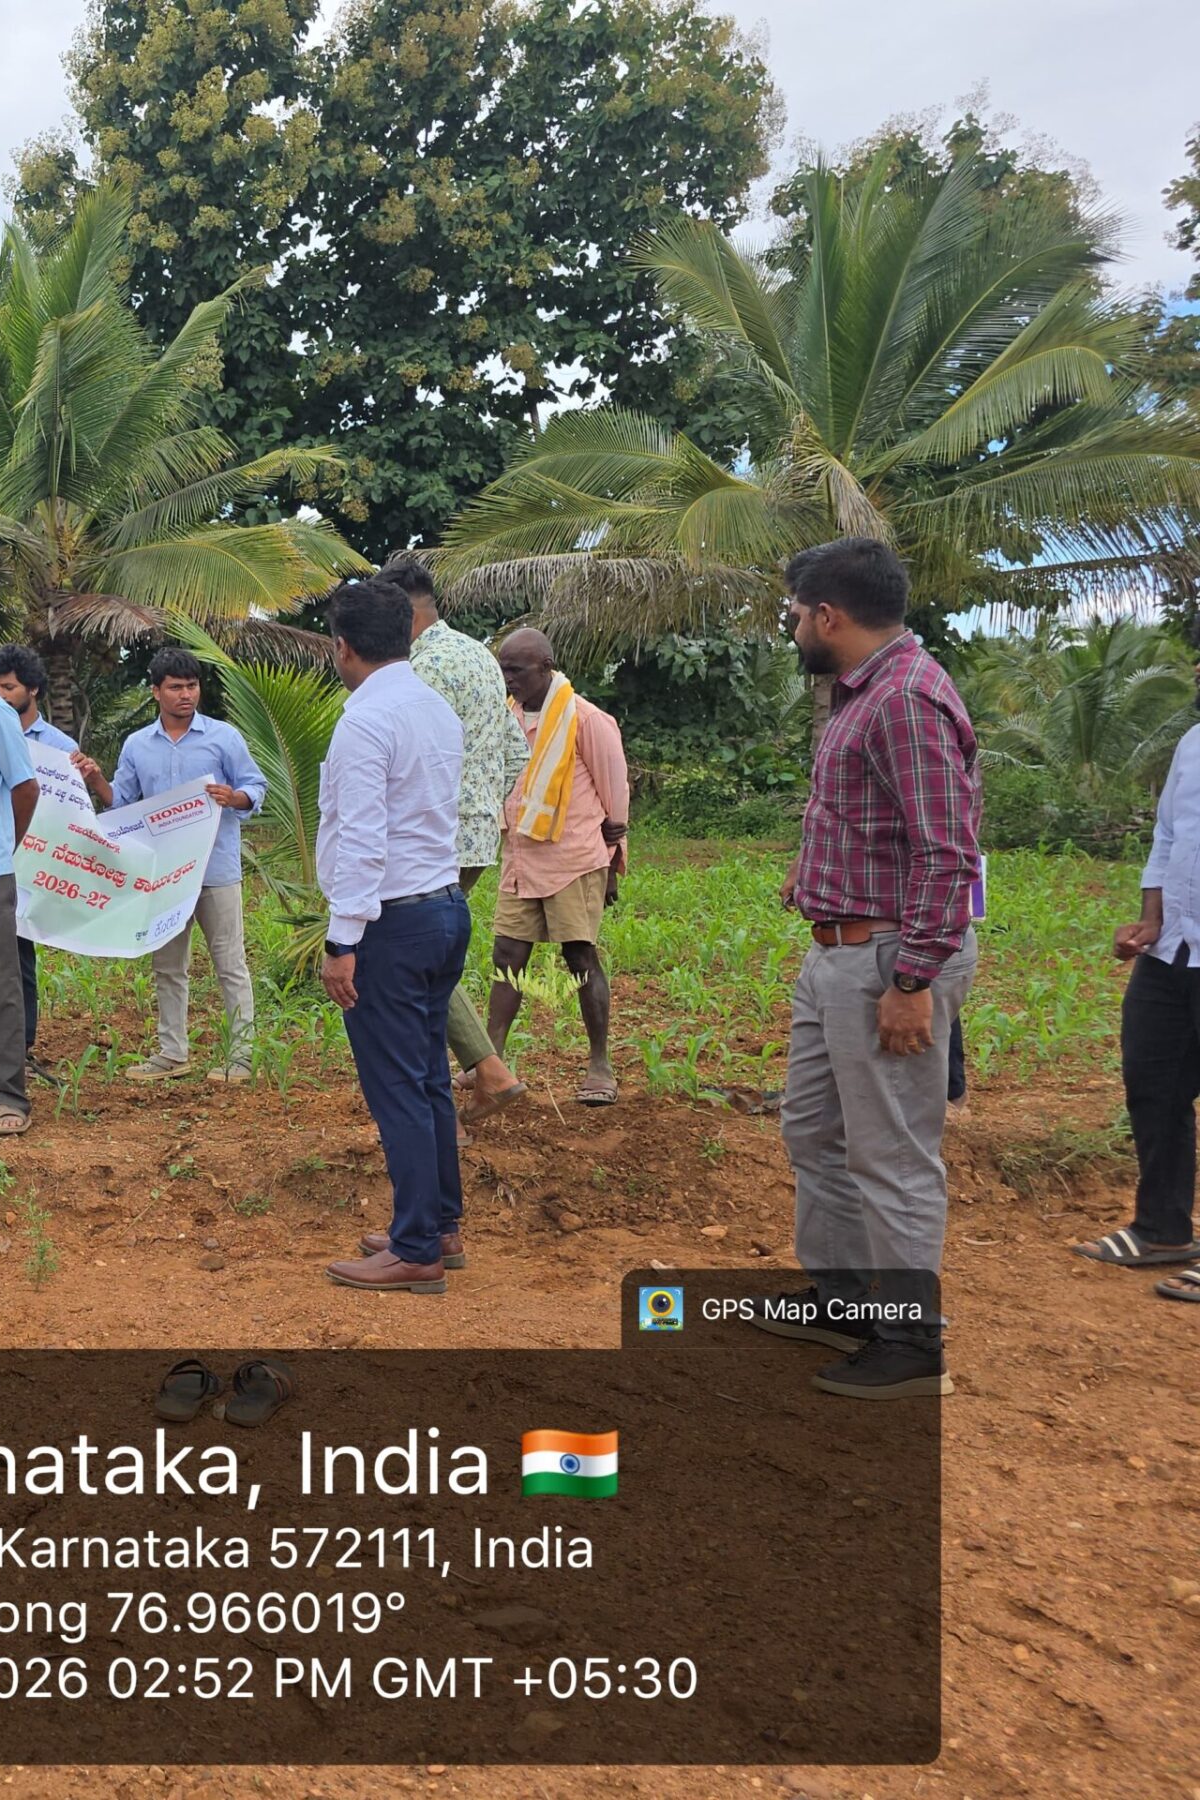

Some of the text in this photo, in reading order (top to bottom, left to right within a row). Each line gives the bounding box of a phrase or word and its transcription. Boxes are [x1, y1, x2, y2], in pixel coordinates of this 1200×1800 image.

[149, 798, 205, 824] HONDA
[171, 810, 204, 825] FOUNDATION
[32, 870, 112, 910] 2026-27
